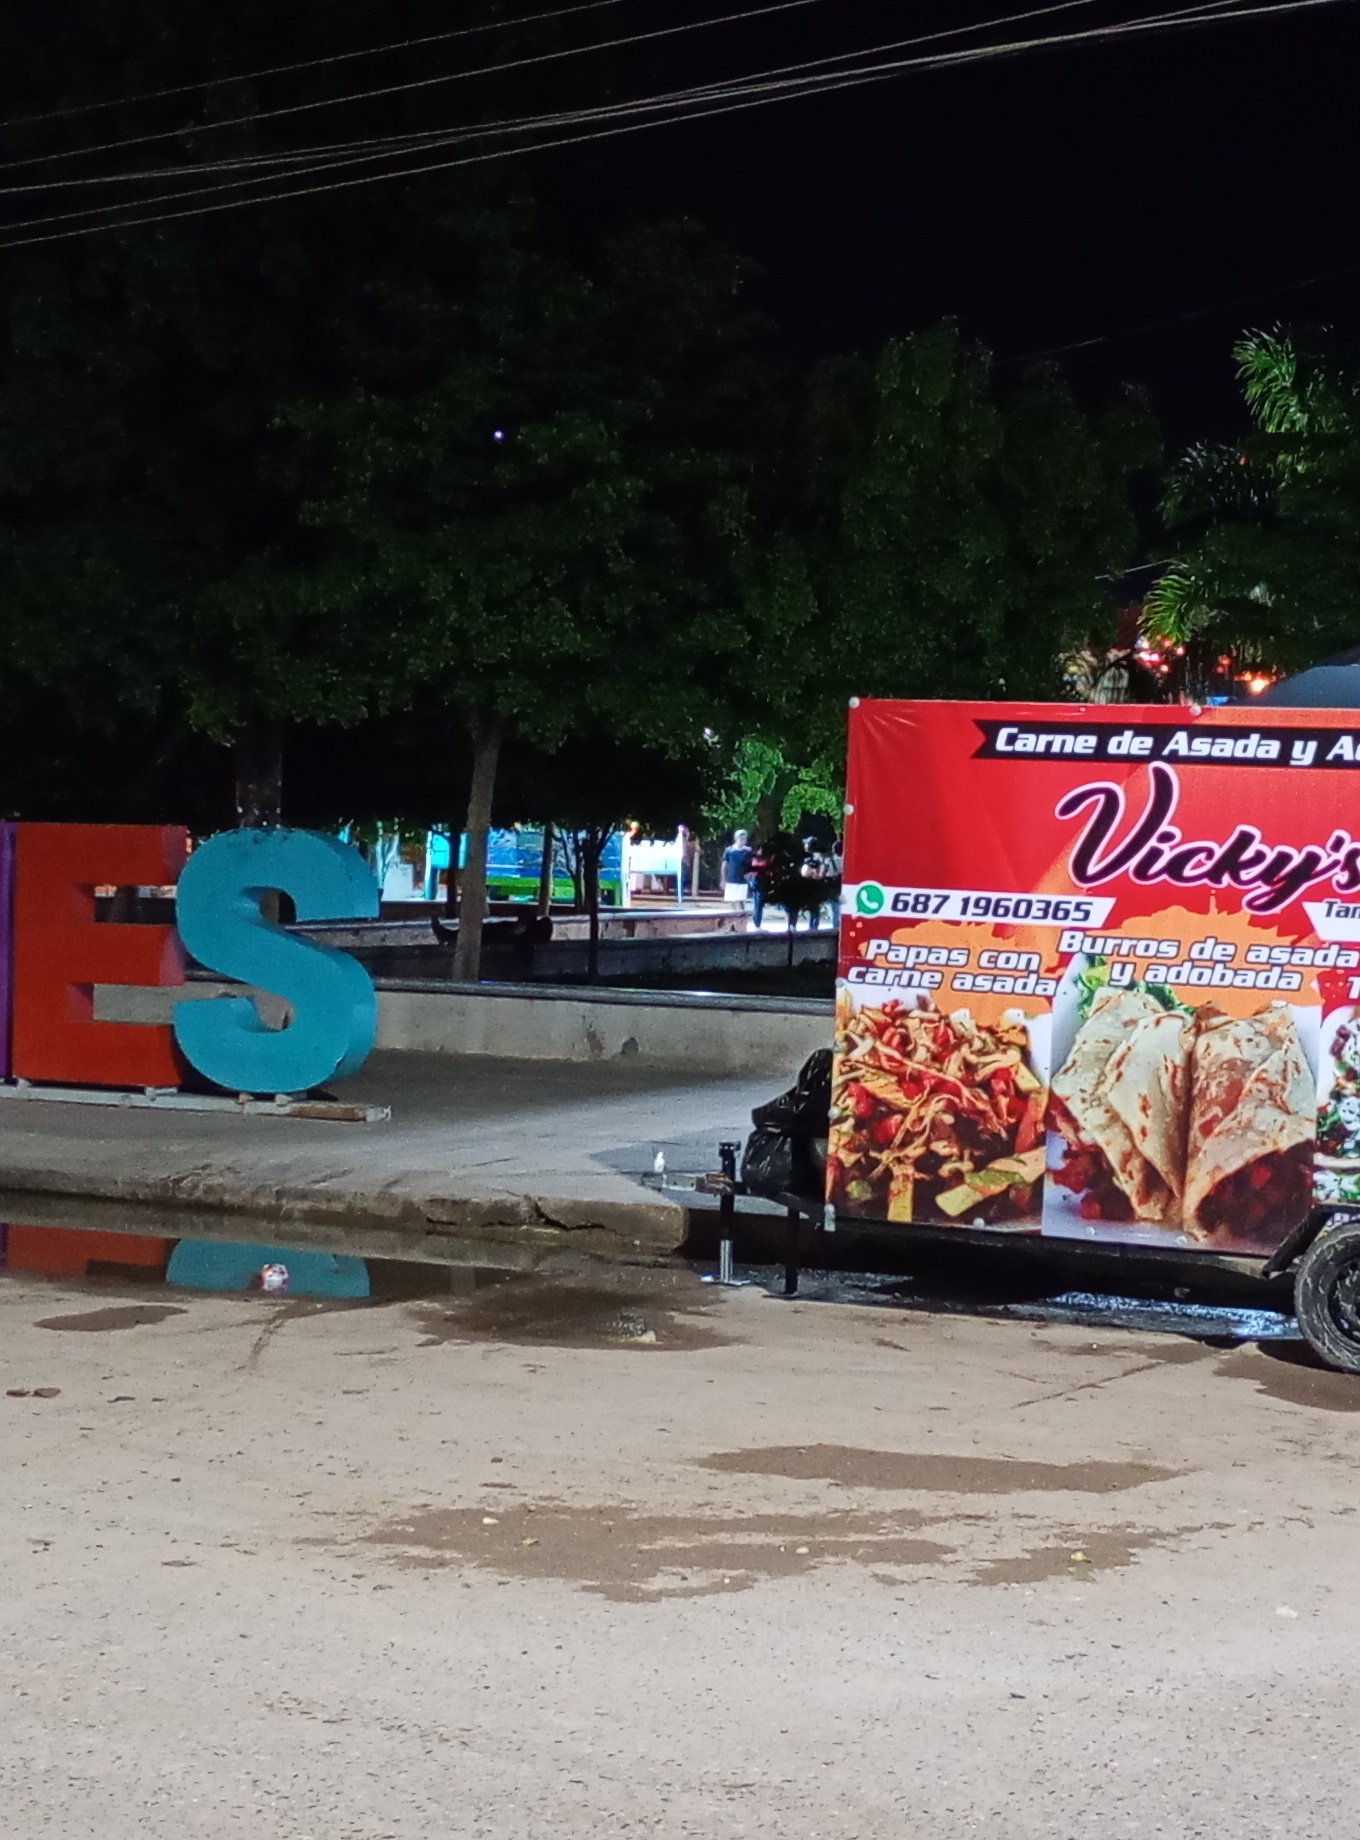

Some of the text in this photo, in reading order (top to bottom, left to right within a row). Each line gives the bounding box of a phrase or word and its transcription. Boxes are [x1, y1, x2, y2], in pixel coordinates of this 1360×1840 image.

[996, 727, 1096, 754] Carne
[1107, 730, 1151, 756] de
[1162, 732, 1280, 759] Asada
[1289, 740, 1318, 765] y
[891, 892, 1093, 922] 687 1960365
[865, 939, 1041, 971] Papas con
[1057, 930, 1360, 968] Burros de asada
[847, 964, 1057, 997] carne asada
[1109, 961, 1302, 991] y adobada
